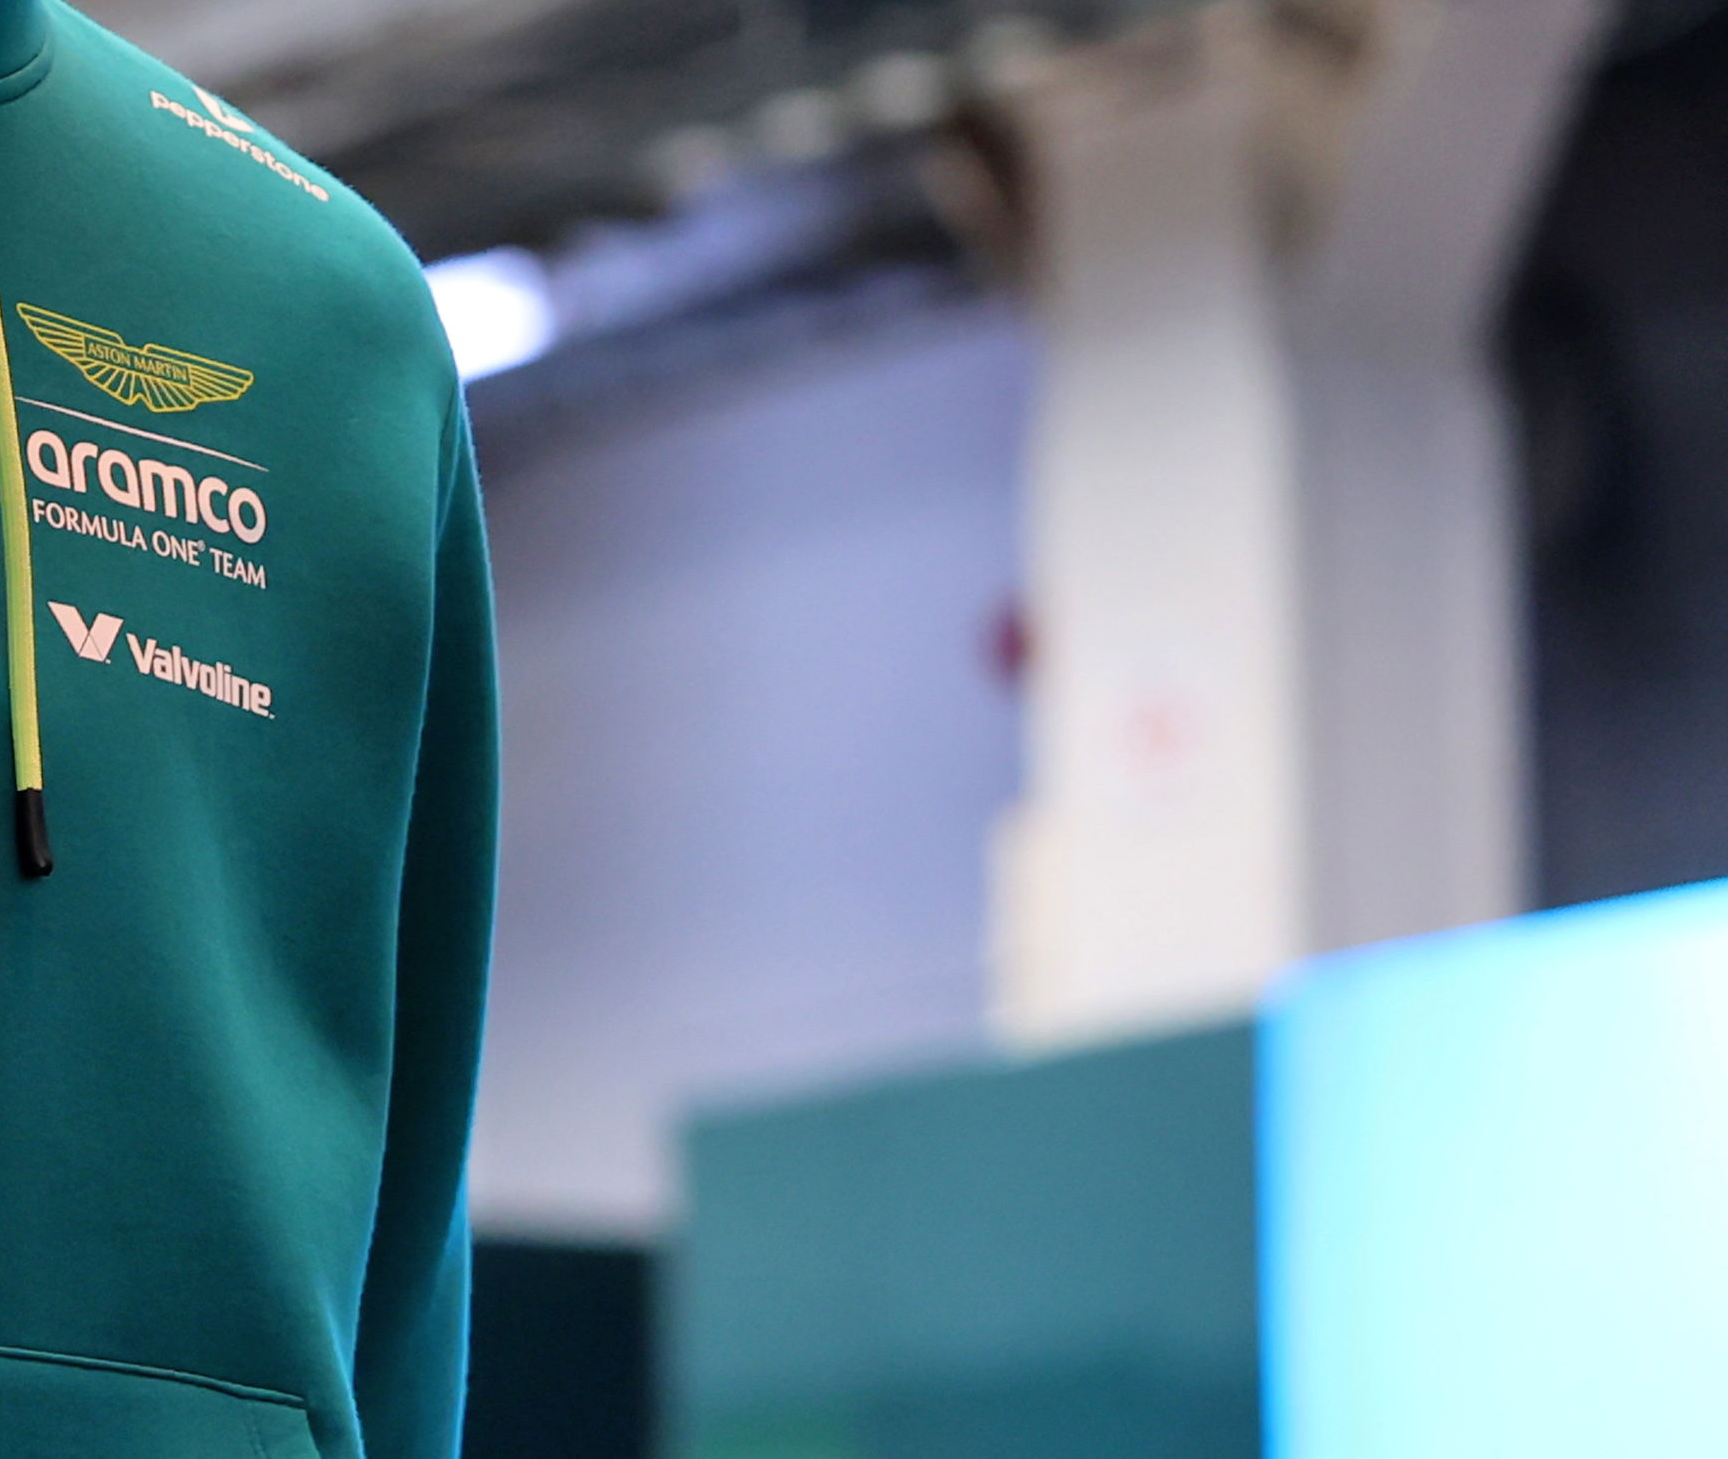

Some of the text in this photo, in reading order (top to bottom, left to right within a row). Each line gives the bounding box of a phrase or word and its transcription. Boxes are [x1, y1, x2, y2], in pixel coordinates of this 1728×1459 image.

[149, 90, 330, 202] pepperstone
[87, 342, 189, 382] ASTON MARTIN
[26, 430, 268, 544] aramco
[32, 498, 148, 551] FORMULA
[209, 547, 267, 590] TEAM
